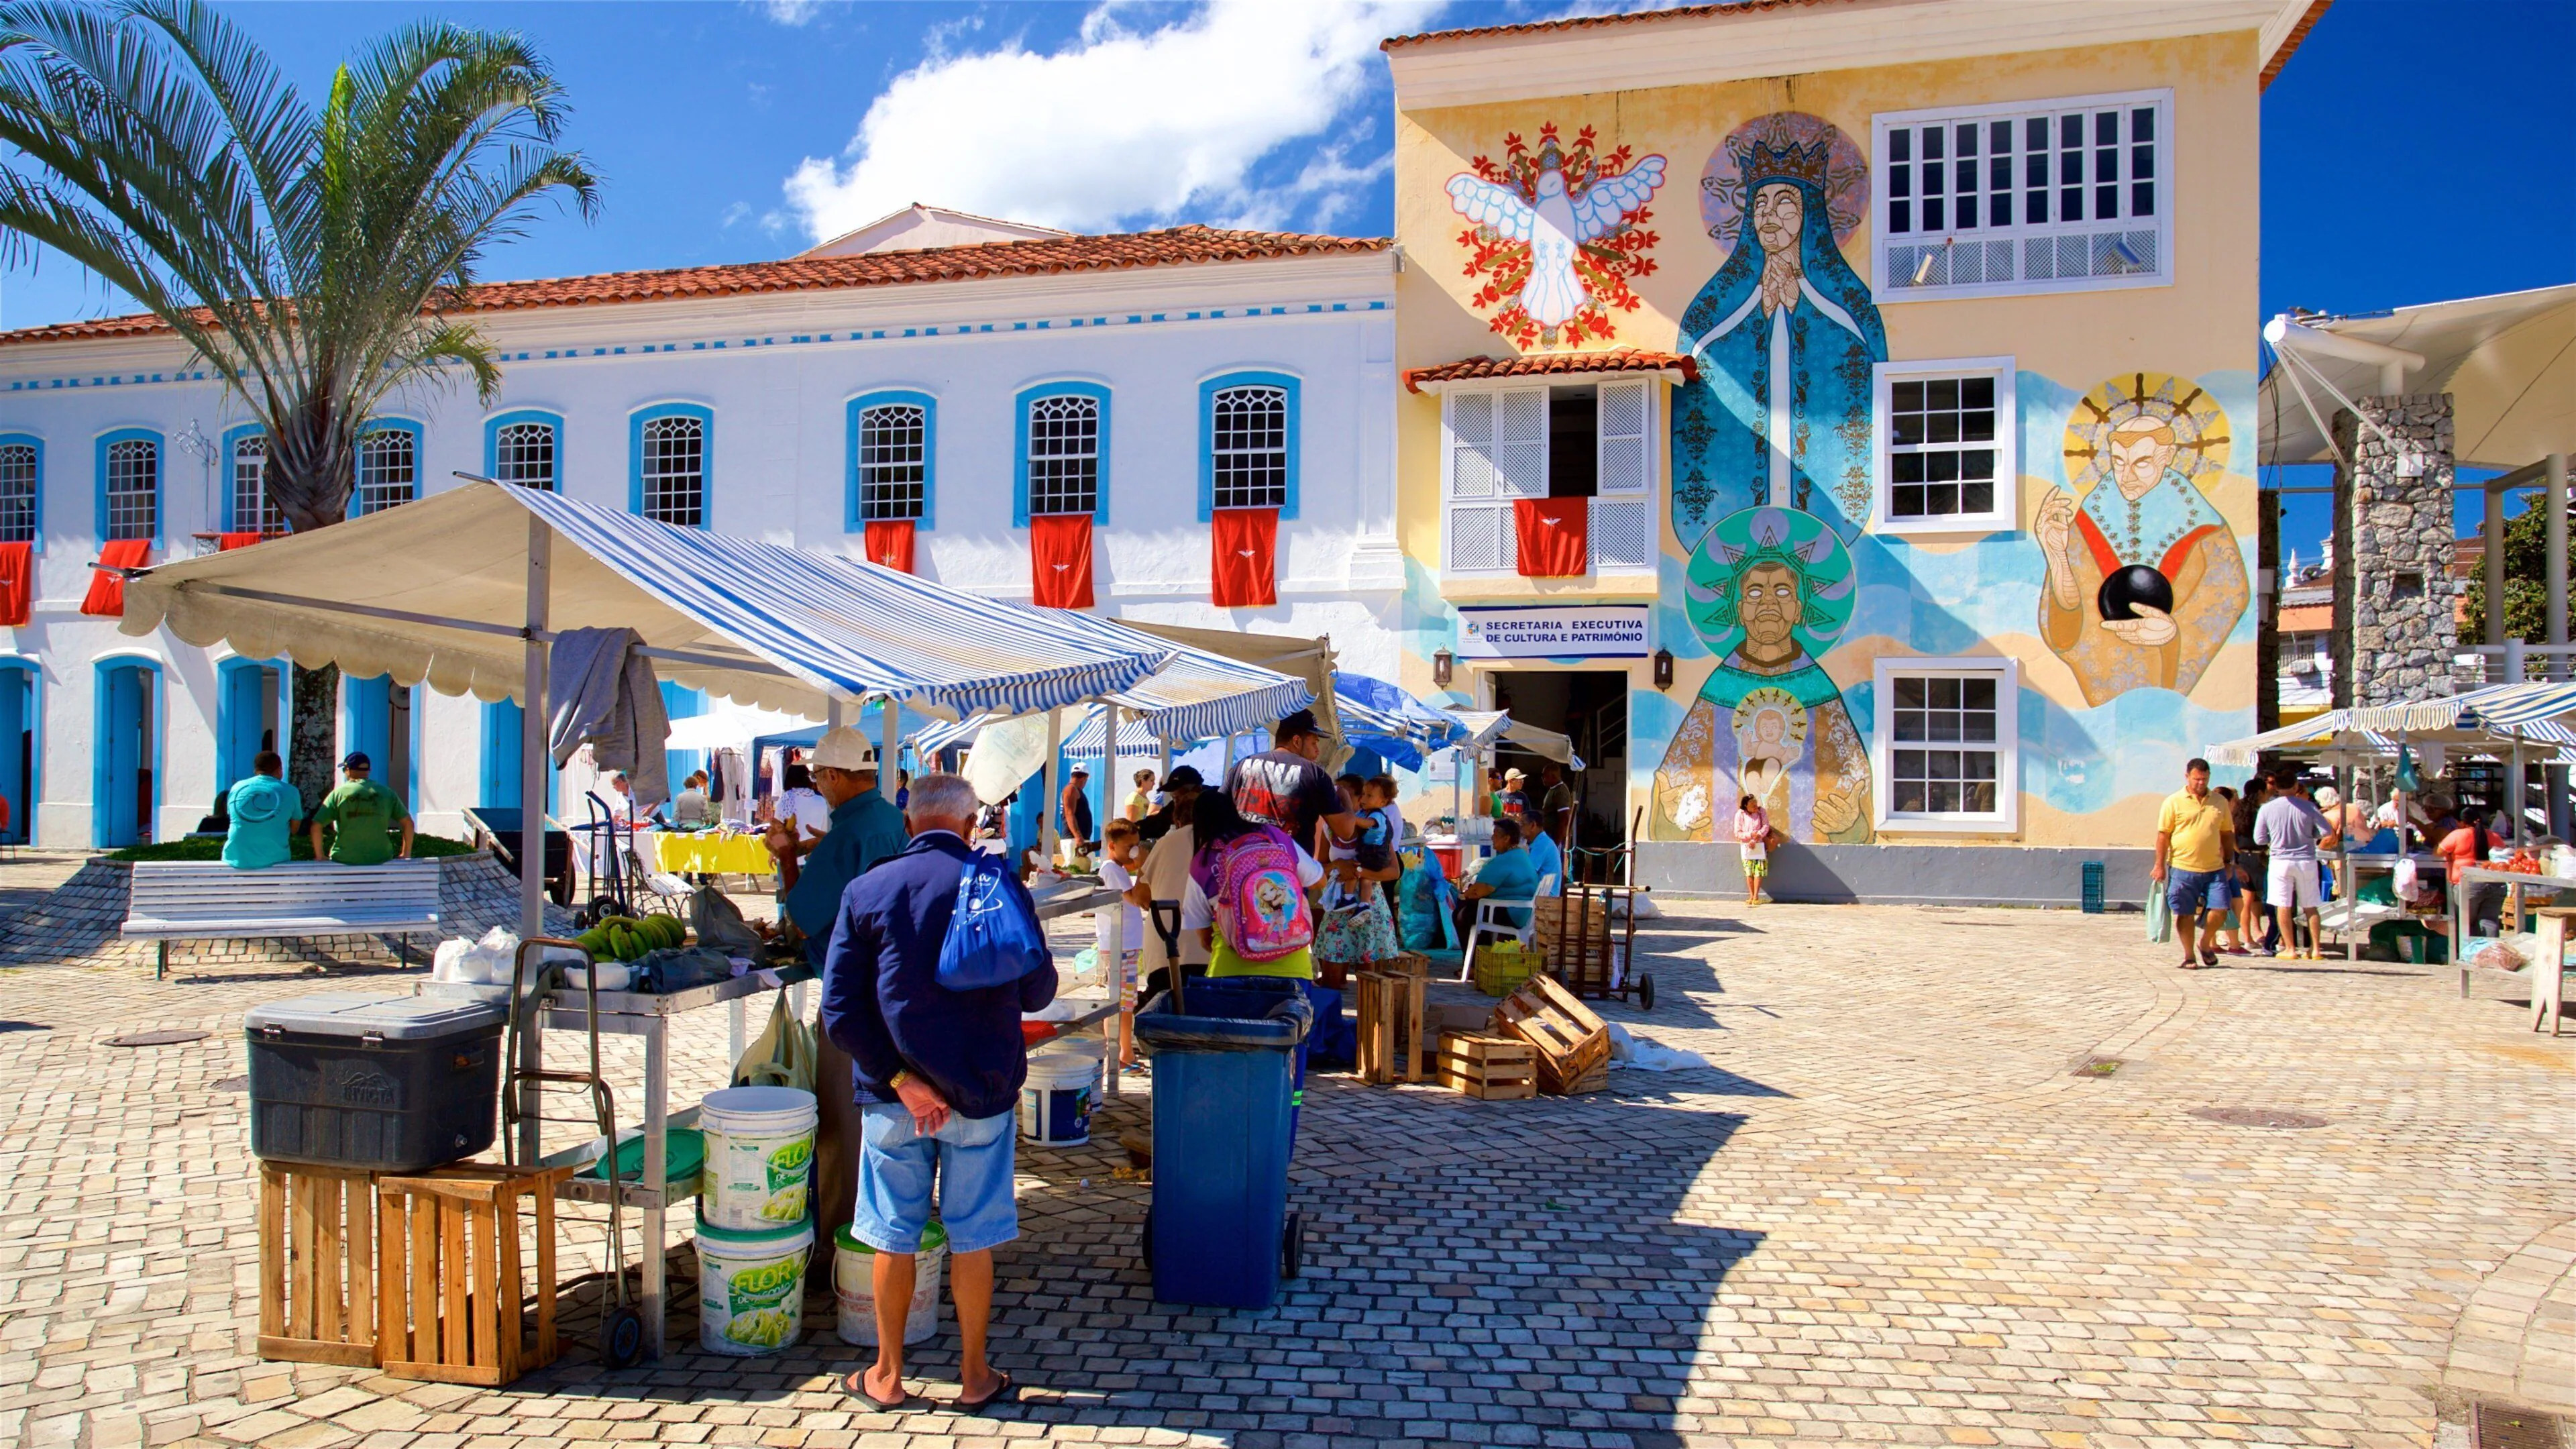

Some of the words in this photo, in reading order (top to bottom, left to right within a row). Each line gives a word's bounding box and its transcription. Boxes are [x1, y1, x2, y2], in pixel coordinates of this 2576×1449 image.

[1486, 622, 1562, 630] SECRETARIA
[1572, 621, 1643, 629] EXECUTIVA
[1487, 633, 1501, 642] DE
[1504, 633, 1557, 642] CULTURA
[1561, 633, 1568, 641] E
[1572, 631, 1643, 641] PATRIMÔNIO
[343, 1084, 396, 1104] INVICTA
[735, 1263, 792, 1295] FLOR
